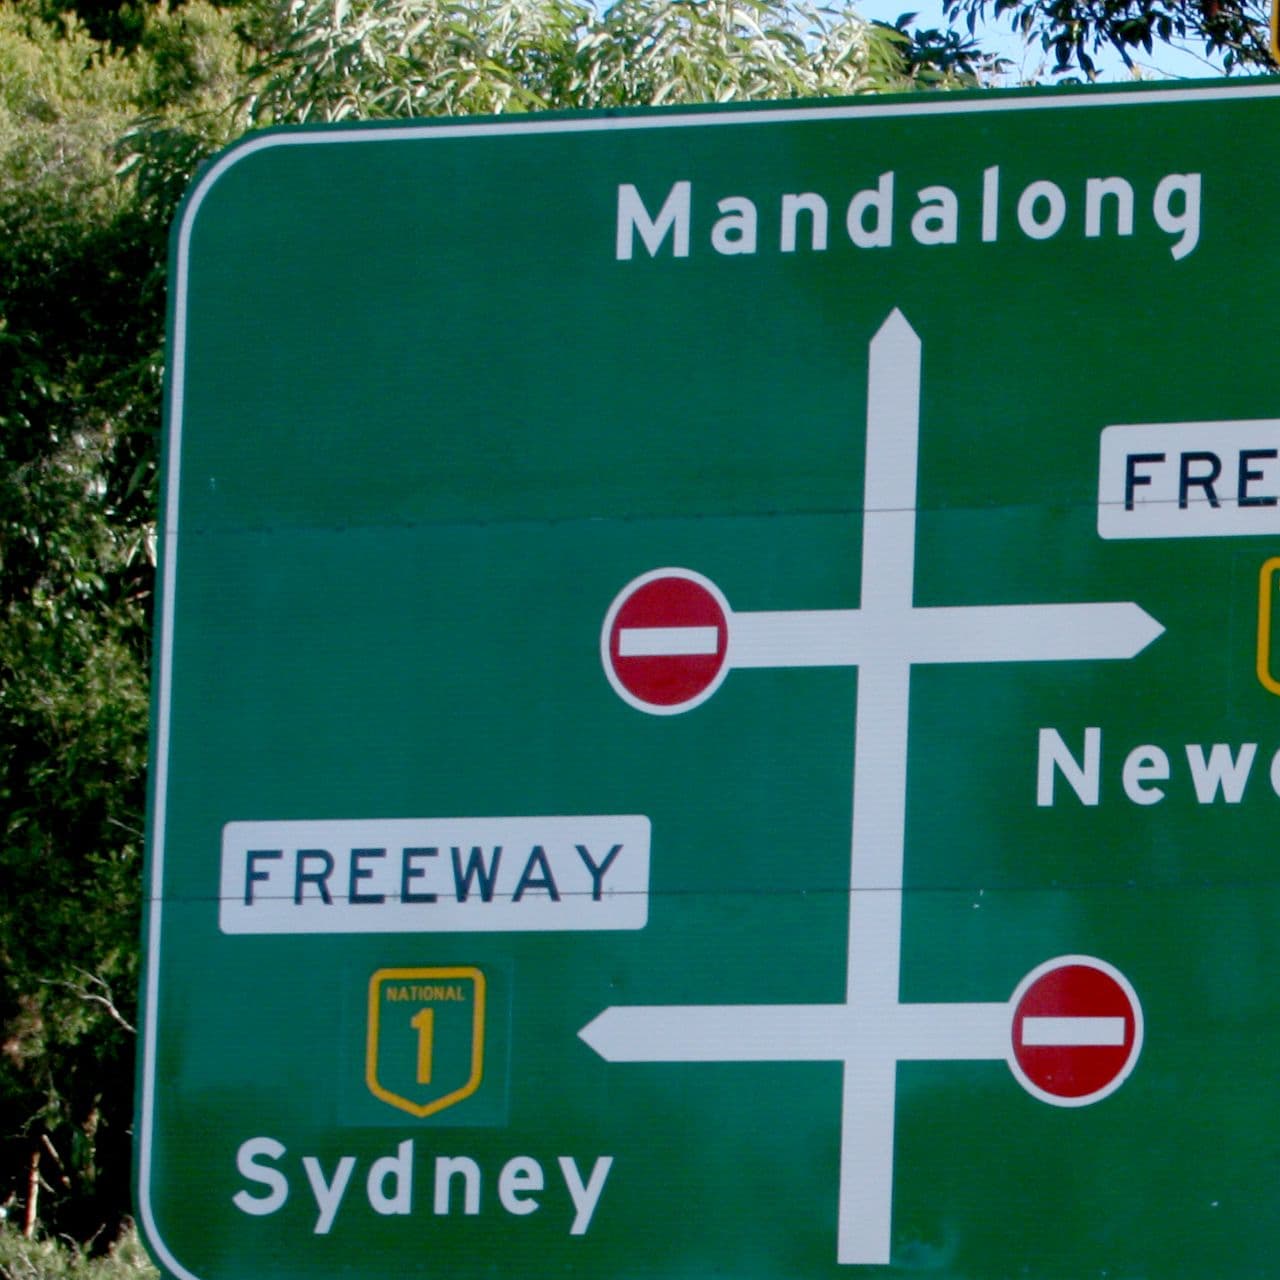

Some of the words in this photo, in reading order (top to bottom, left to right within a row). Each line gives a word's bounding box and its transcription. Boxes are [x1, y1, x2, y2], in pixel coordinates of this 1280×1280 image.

[616, 165, 1201, 261] Mandalong
[243, 844, 624, 907] FREEWAY
[386, 985, 465, 1002] NATIONAL
[410, 1007, 434, 1085] 1
[232, 1137, 613, 1236] Sydney
